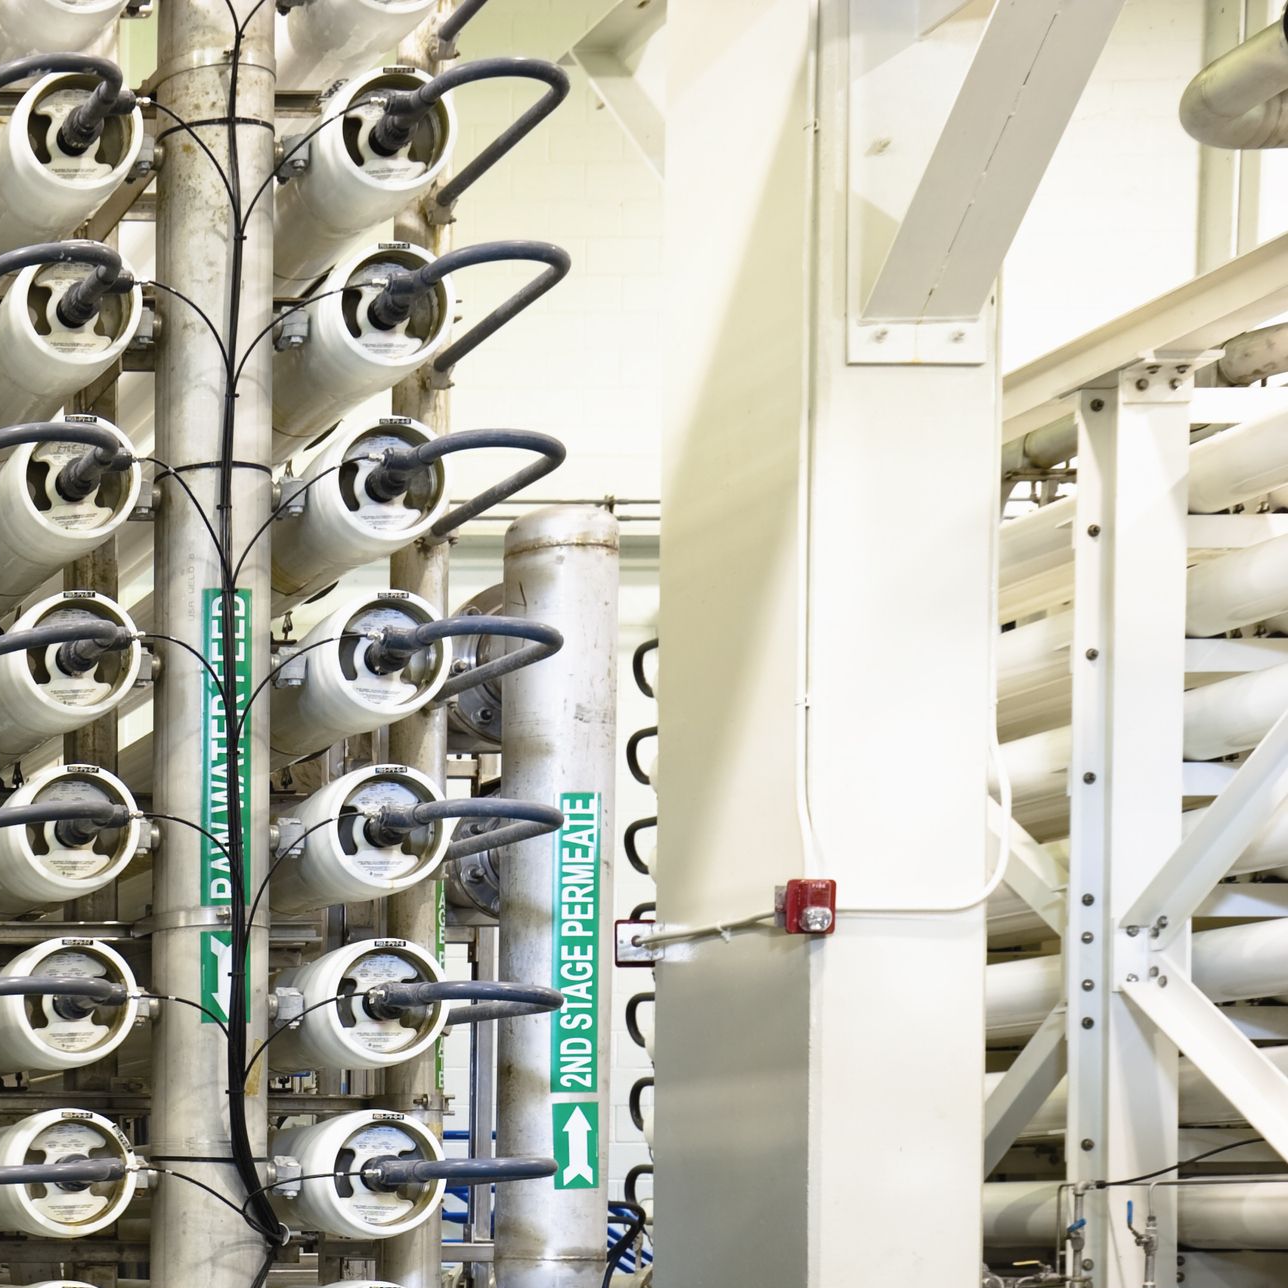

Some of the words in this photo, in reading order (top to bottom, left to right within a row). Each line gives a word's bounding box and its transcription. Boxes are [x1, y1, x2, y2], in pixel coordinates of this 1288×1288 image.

[561, 798, 598, 937] PERMEATE
[560, 944, 593, 1030] STAGE
[560, 1037, 592, 1088] 2ND
